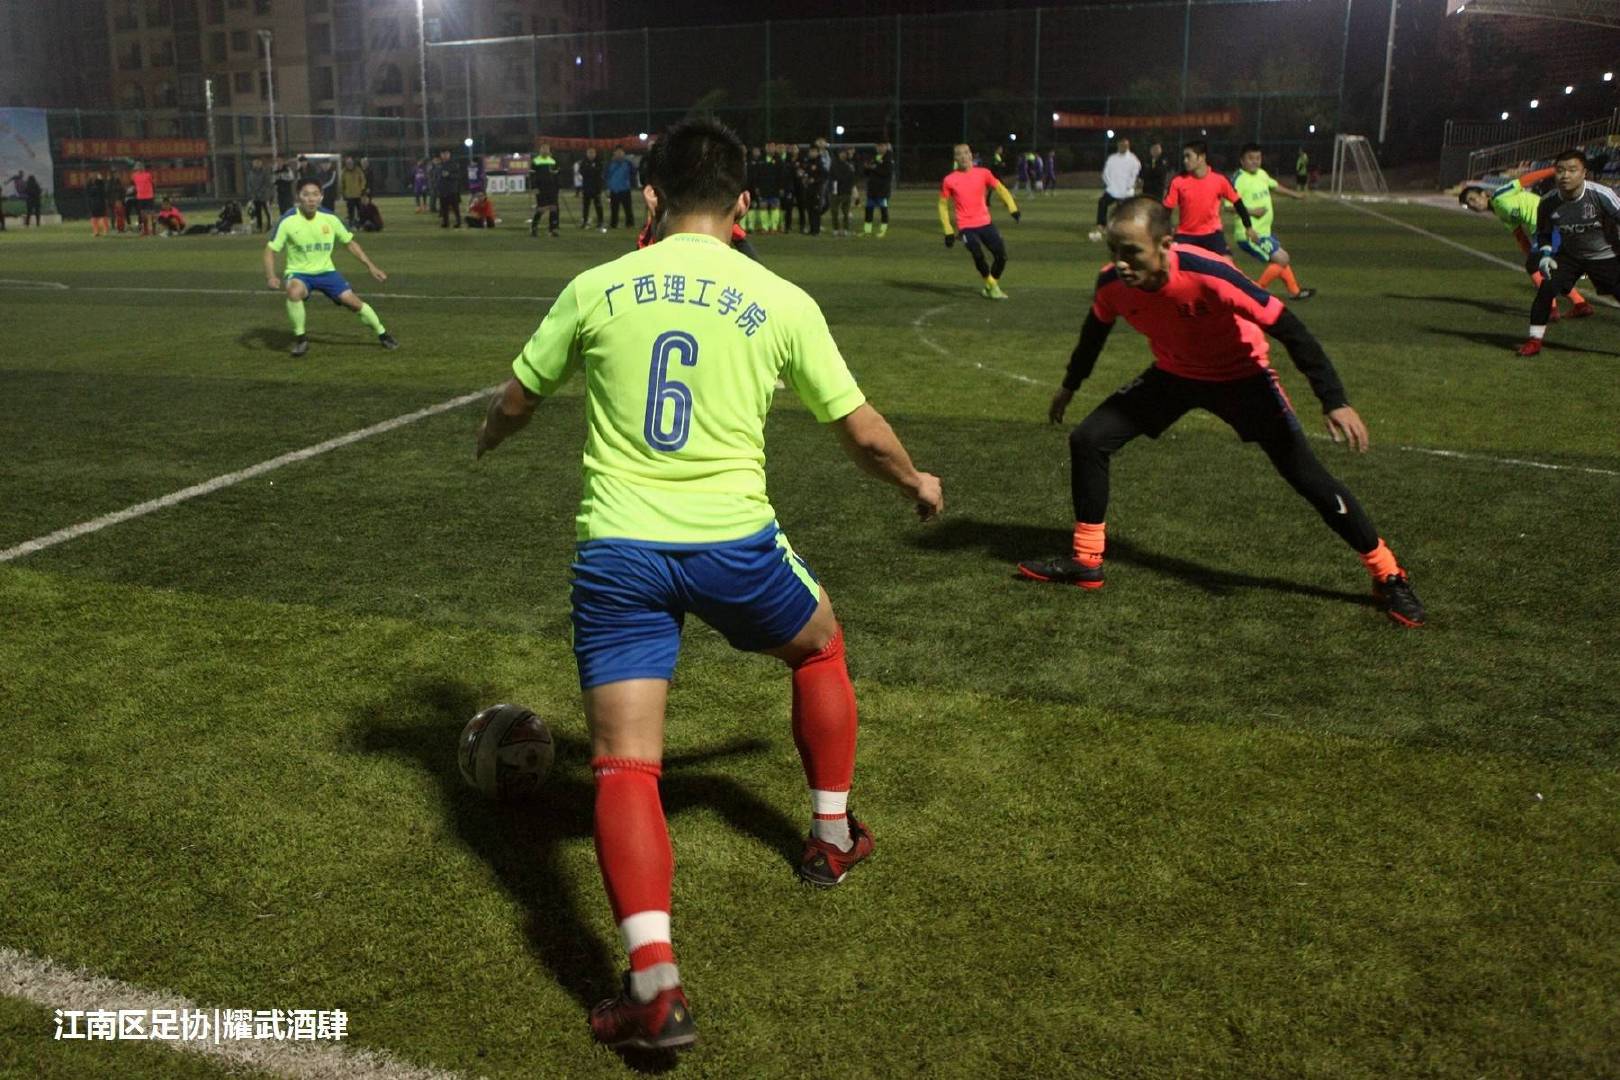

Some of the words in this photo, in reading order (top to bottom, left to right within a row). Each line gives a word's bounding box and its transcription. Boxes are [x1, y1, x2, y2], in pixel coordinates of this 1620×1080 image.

[605, 274, 767, 337] 广西理工学院
[643, 330, 699, 452] 6
